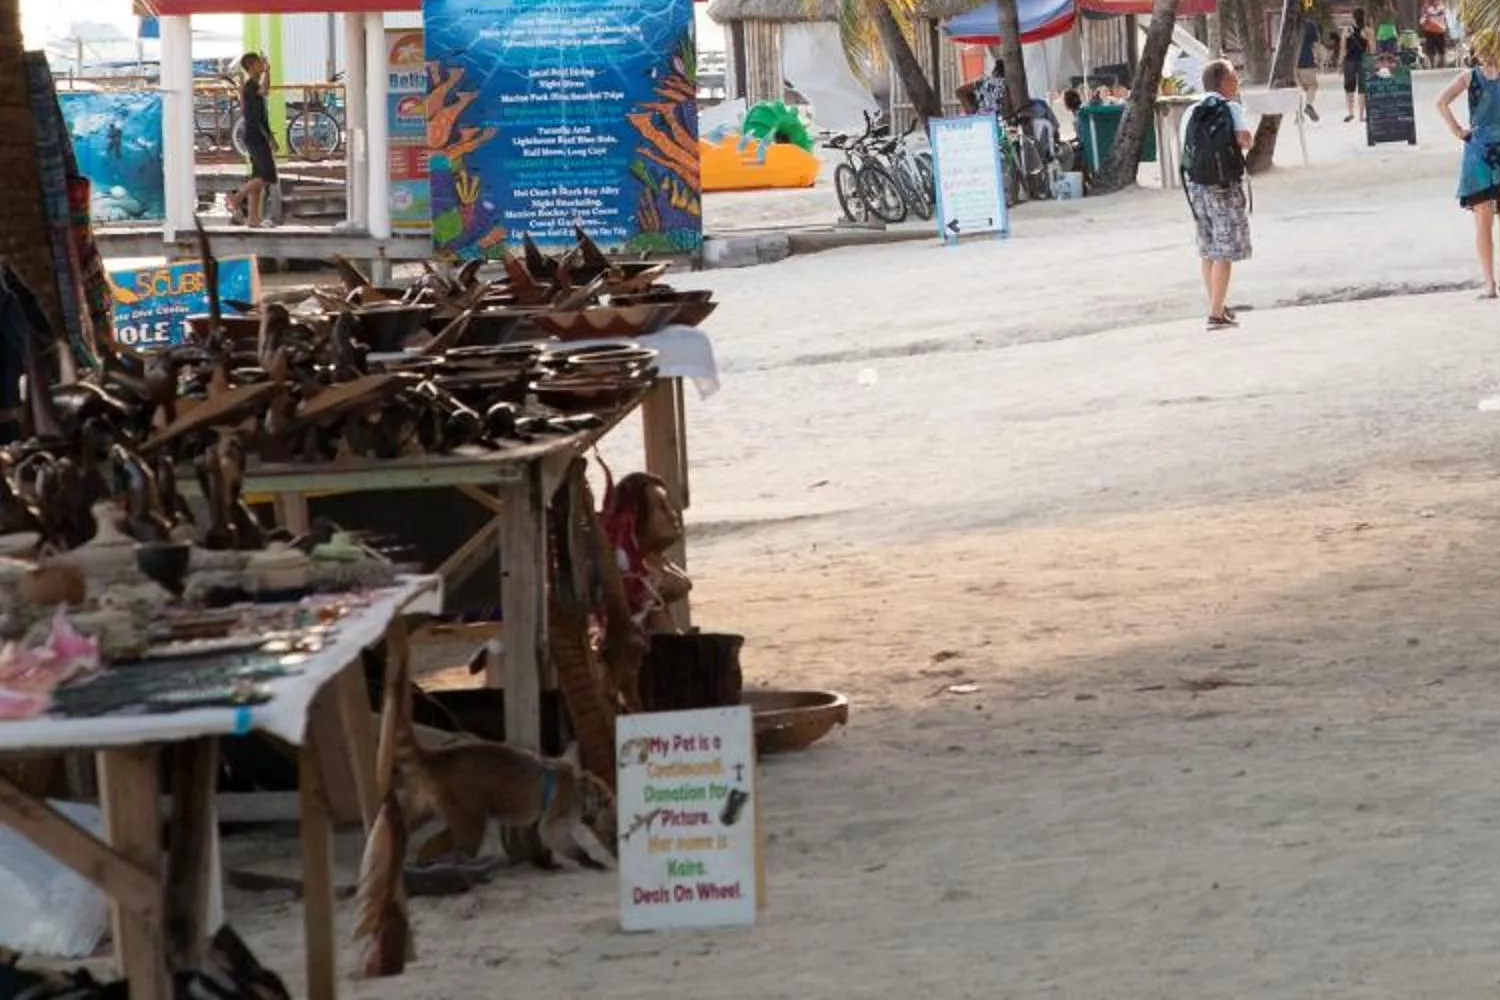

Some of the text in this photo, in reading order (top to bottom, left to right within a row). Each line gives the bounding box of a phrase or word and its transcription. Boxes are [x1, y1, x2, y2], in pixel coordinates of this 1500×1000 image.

[648, 736, 669, 758] My
[673, 734, 695, 751] Pet
[698, 733, 710, 751] is
[644, 782, 728, 803] Donation for
[673, 885, 692, 902] On
